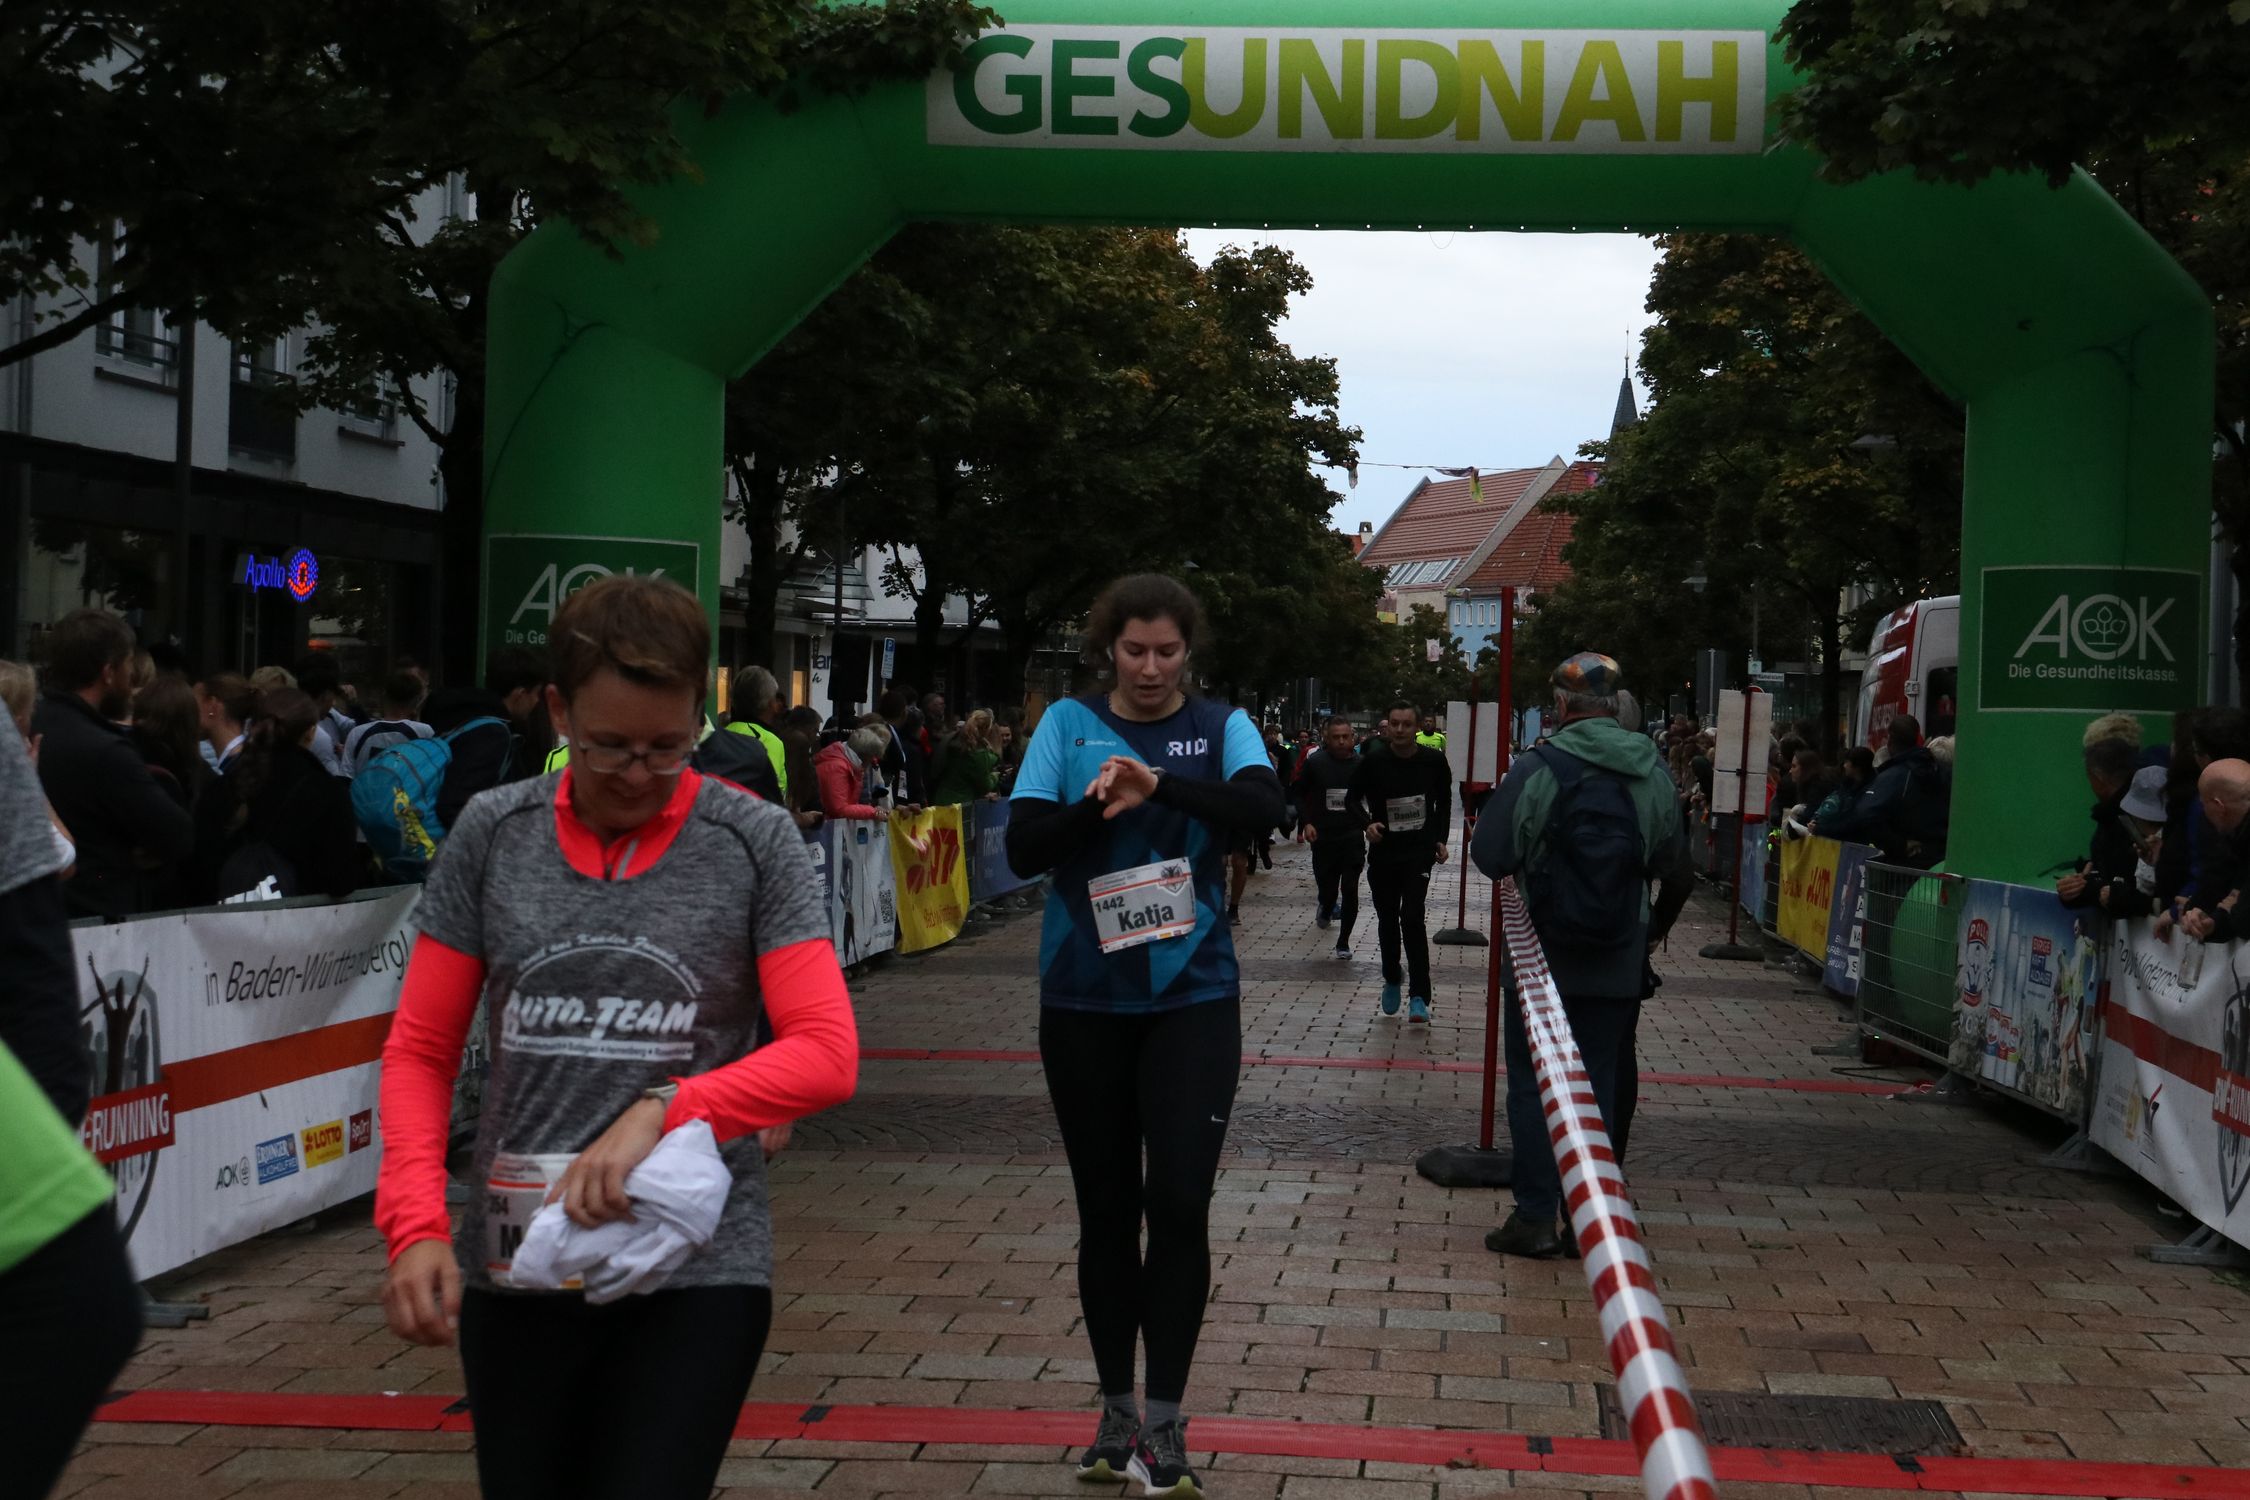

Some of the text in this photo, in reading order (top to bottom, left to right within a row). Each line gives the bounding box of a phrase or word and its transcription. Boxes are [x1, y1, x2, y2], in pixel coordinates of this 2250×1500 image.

[953, 34, 1738, 143] GESUNDNAH
[244, 553, 286, 593] Apollo
[505, 629, 524, 644] Die
[2013, 593, 2176, 661] AOK
[2008, 663, 2031, 678] Die
[1394, 810, 1420, 820] Daniel
[1095, 896, 1125, 912] 1442
[1118, 904, 1174, 932] Katja
[205, 962, 219, 1006] in
[314, 1126, 342, 1149] LOTTO
[215, 1165, 239, 1190] AOK
